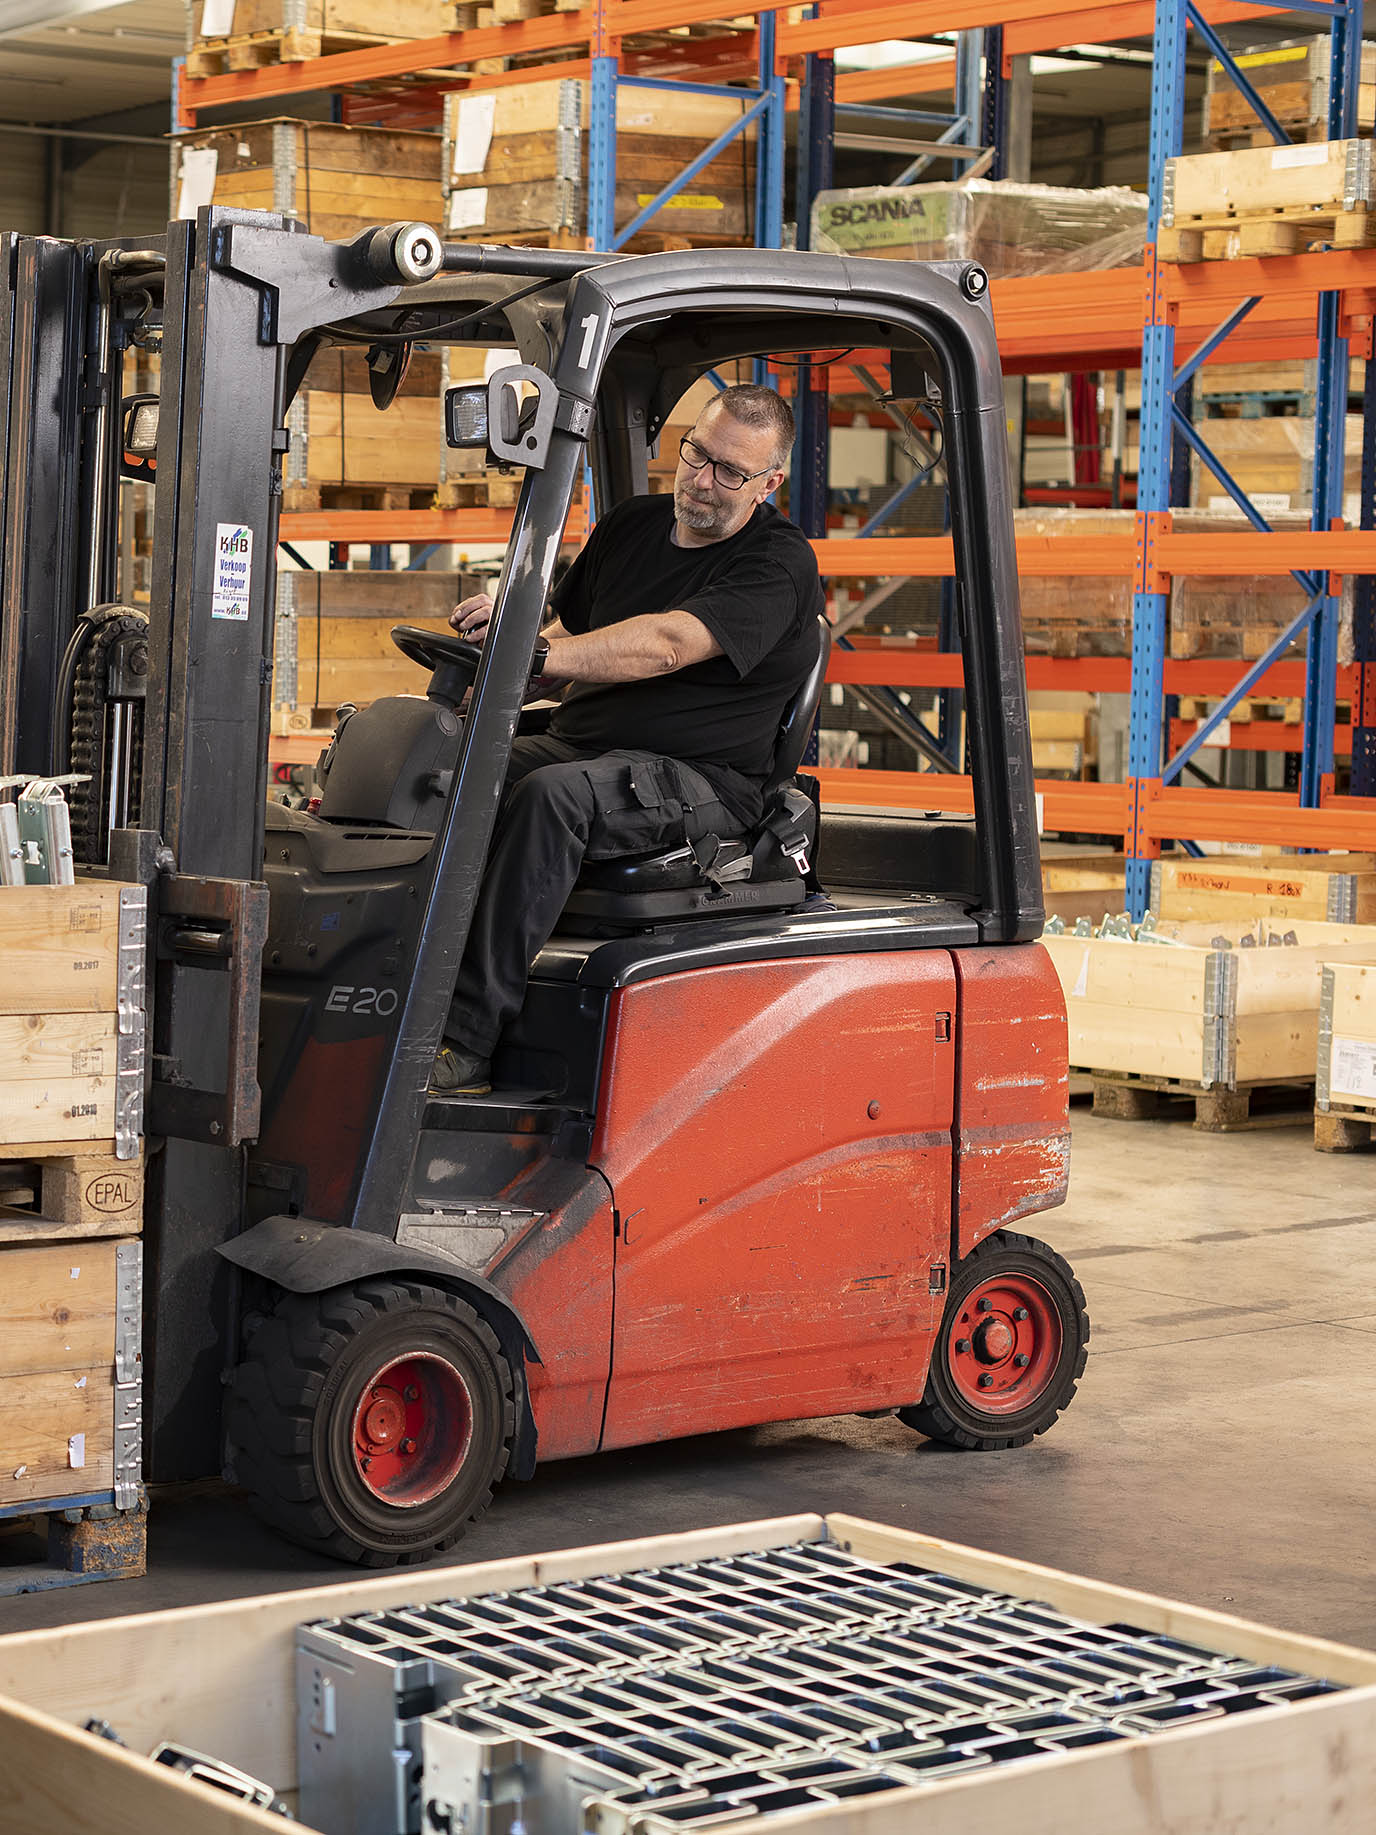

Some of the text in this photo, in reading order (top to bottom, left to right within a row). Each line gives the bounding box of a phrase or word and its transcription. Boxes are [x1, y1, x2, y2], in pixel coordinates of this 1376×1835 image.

[831, 198, 926, 226] SCANIA
[578, 313, 599, 370] 1
[220, 536, 249, 553] KHB
[220, 559, 247, 574] Verkoop
[219, 575, 245, 590] Verhuur
[95, 1183, 132, 1204] EPAL
